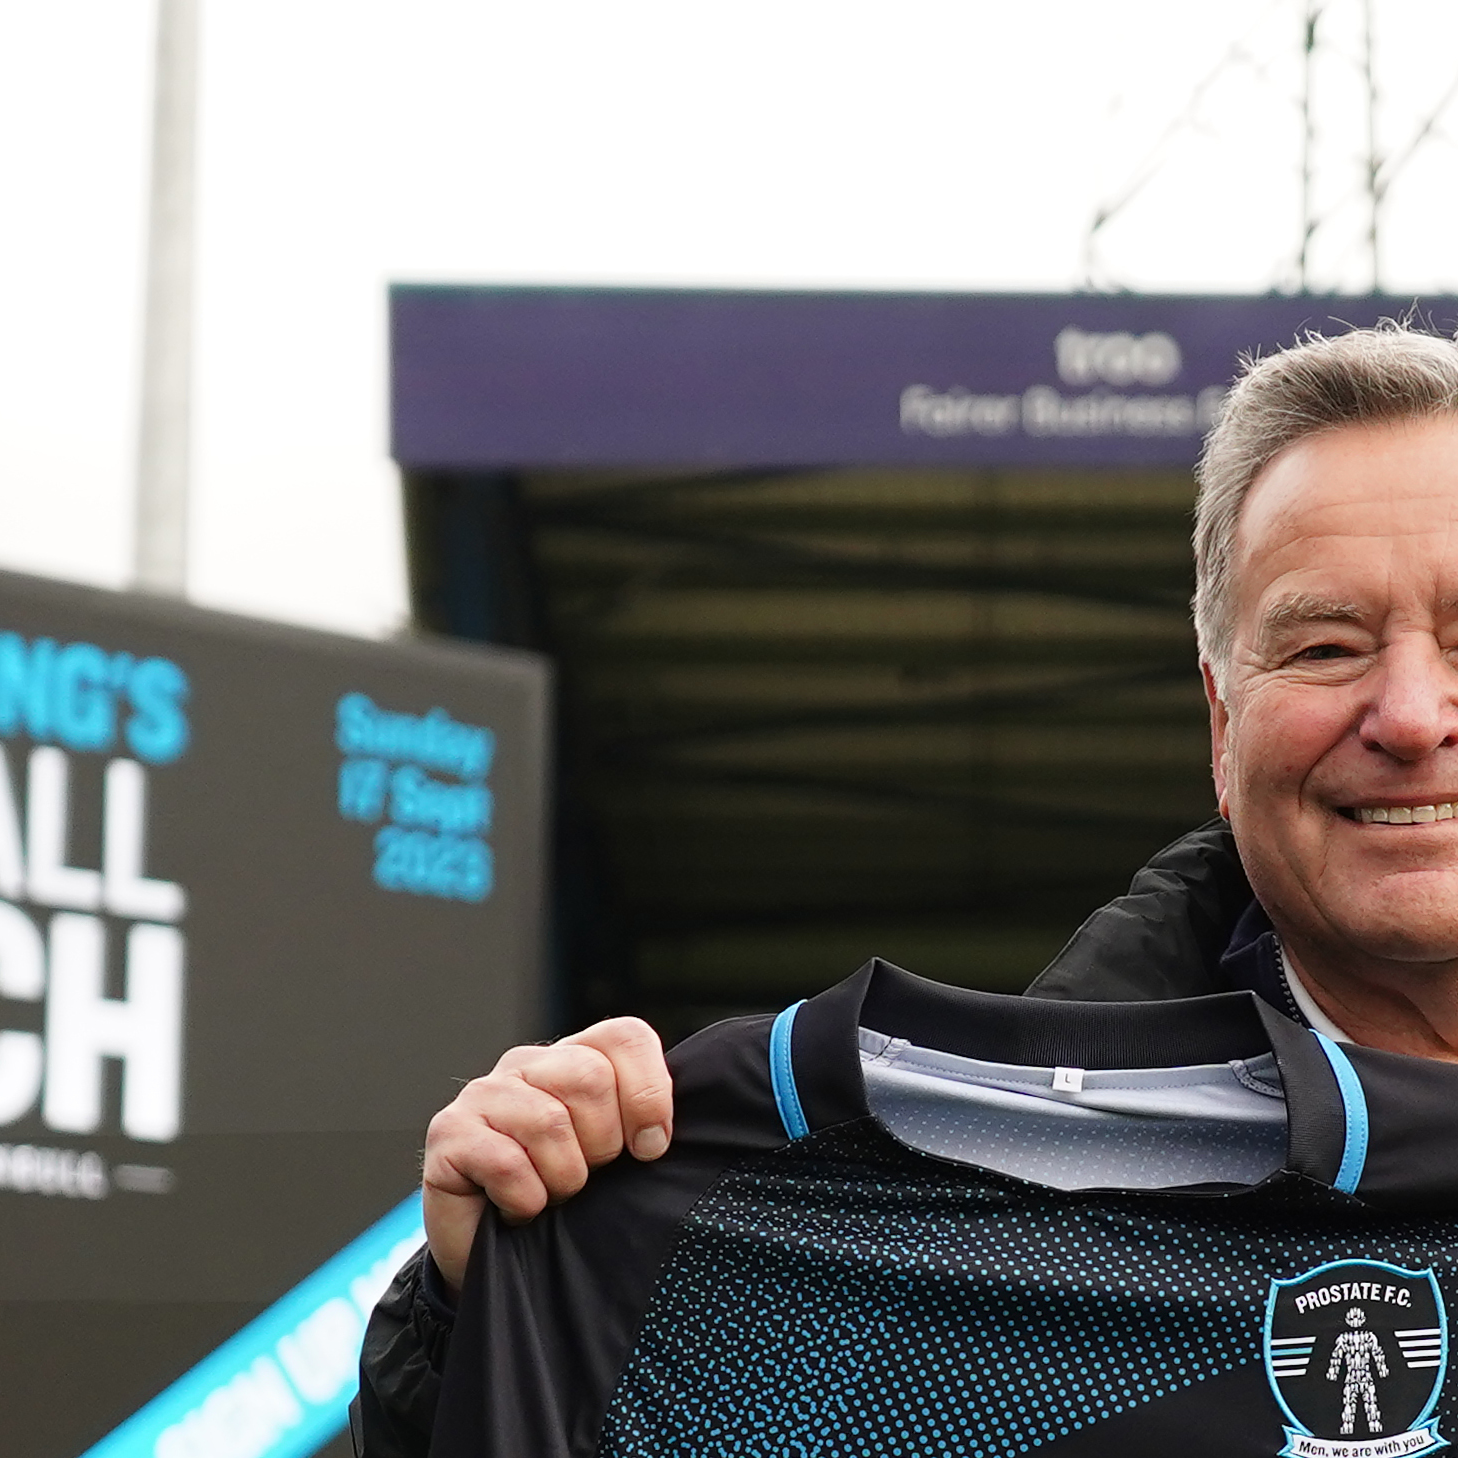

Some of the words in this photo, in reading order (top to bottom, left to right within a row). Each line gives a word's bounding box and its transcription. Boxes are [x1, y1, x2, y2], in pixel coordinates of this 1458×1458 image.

[336, 692, 496, 782] Sunday
[373, 825, 493, 904] 2023
[1295, 1282, 1382, 1314] PROSTATE
[1384, 1285, 1412, 1308] F.C.
[1332, 1447, 1349, 1457] we
[1352, 1447, 1371, 1457] are
[1374, 1440, 1401, 1456] with
[1403, 1435, 1425, 1452] you
